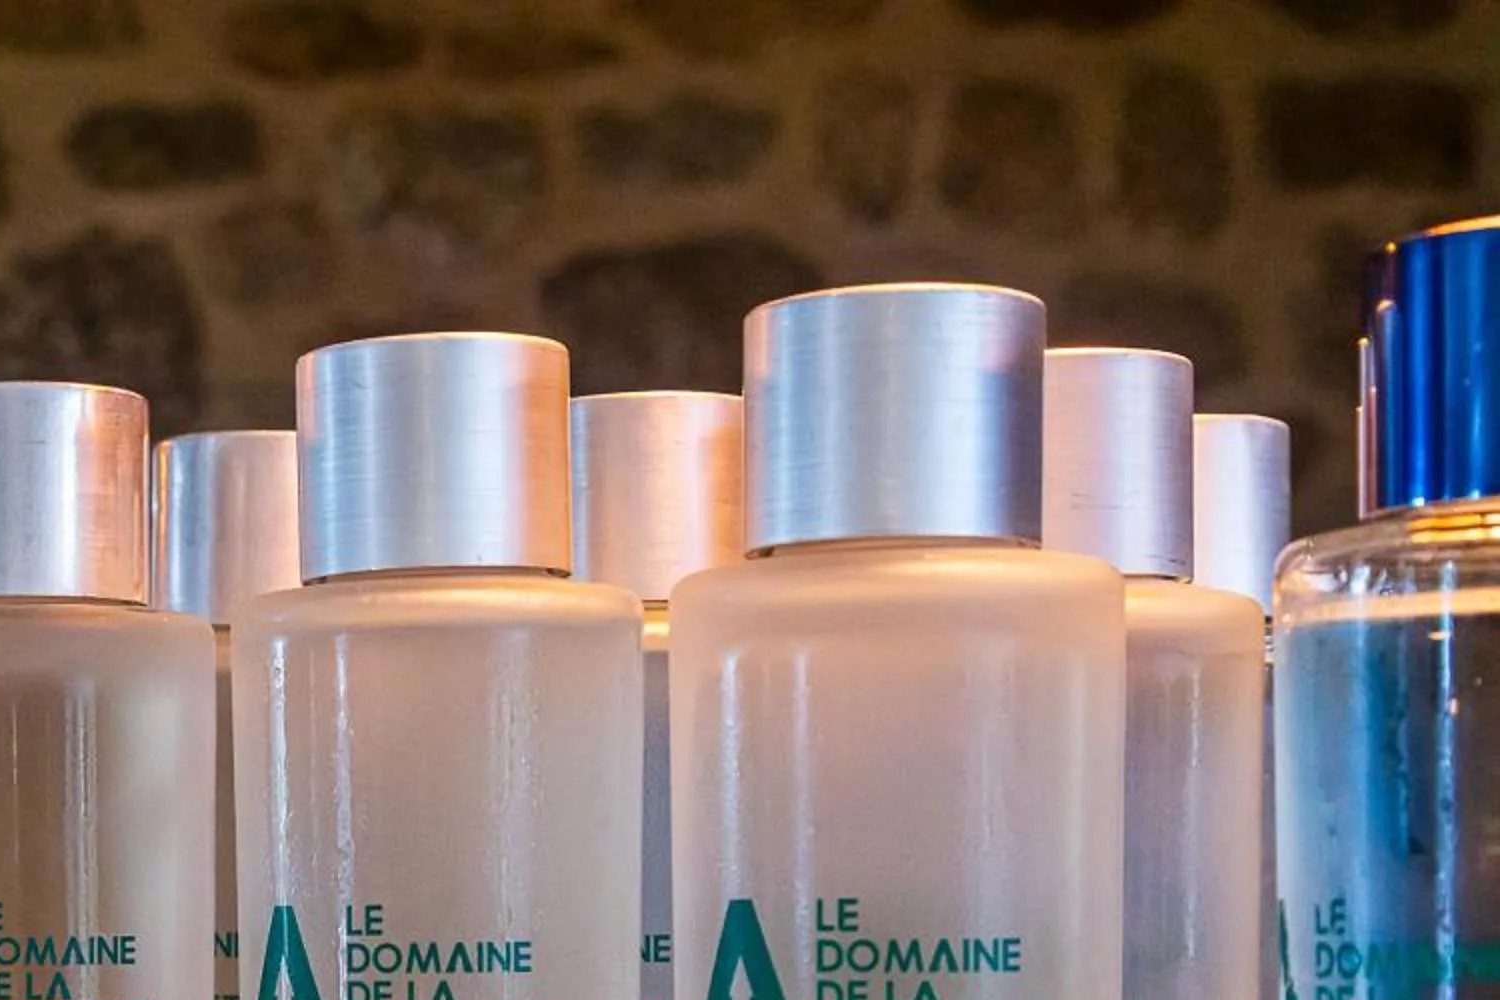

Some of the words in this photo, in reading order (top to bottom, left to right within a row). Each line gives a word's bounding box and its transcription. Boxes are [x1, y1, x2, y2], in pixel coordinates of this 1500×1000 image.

[346, 904, 384, 937] LE
[815, 897, 859, 934] LE
[346, 941, 533, 974] DOMAINE
[816, 938, 1022, 974] DOMAINE
